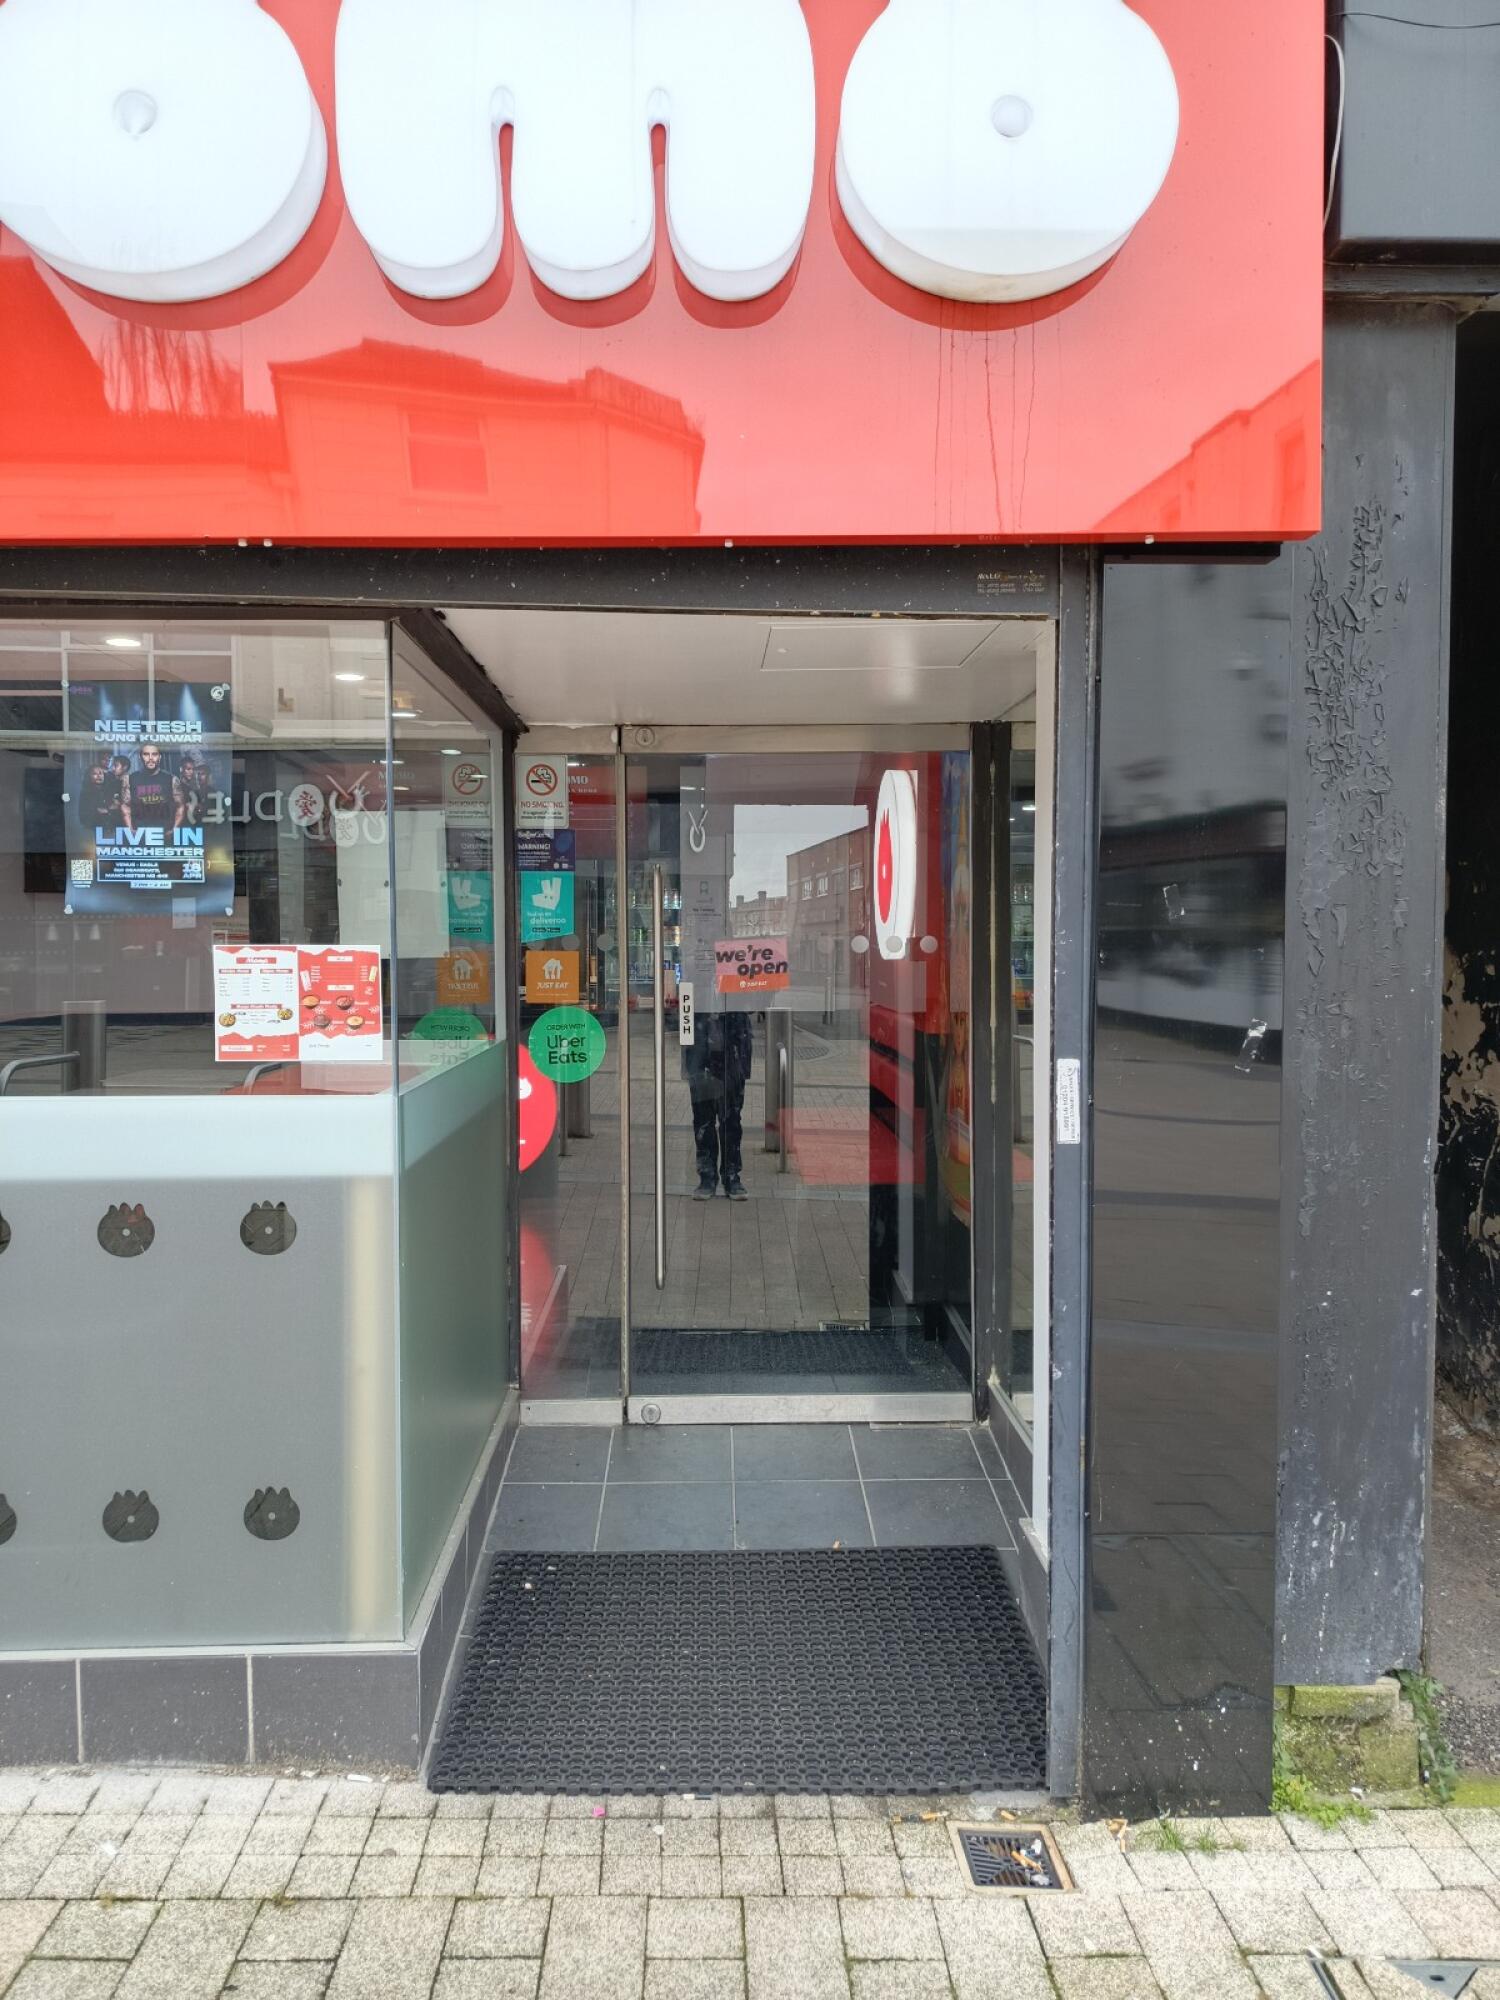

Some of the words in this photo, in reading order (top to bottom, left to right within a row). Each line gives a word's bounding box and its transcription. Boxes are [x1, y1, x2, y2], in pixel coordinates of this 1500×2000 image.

[94, 719, 202, 733] NEETESH
[94, 733, 137, 742] JUNG
[139, 734, 202, 742] KUNWAR
[520, 801, 532, 809] NO
[532, 801, 564, 809] SMONG
[95, 826, 165, 846] LIVE
[173, 826, 204, 846] IN
[95, 846, 204, 857] MANCHESTER
[529, 914, 567, 925] deliveroo
[737, 960, 789, 979] open
[536, 981, 554, 990] JUST
[554, 981, 570, 990] EAT
[682, 994, 691, 1035] PUSH
[546, 1023, 569, 1032] ORDER
[569, 1022, 586, 1031] WITH
[546, 1034, 586, 1050] Uber
[548, 1050, 588, 1065] Eats
